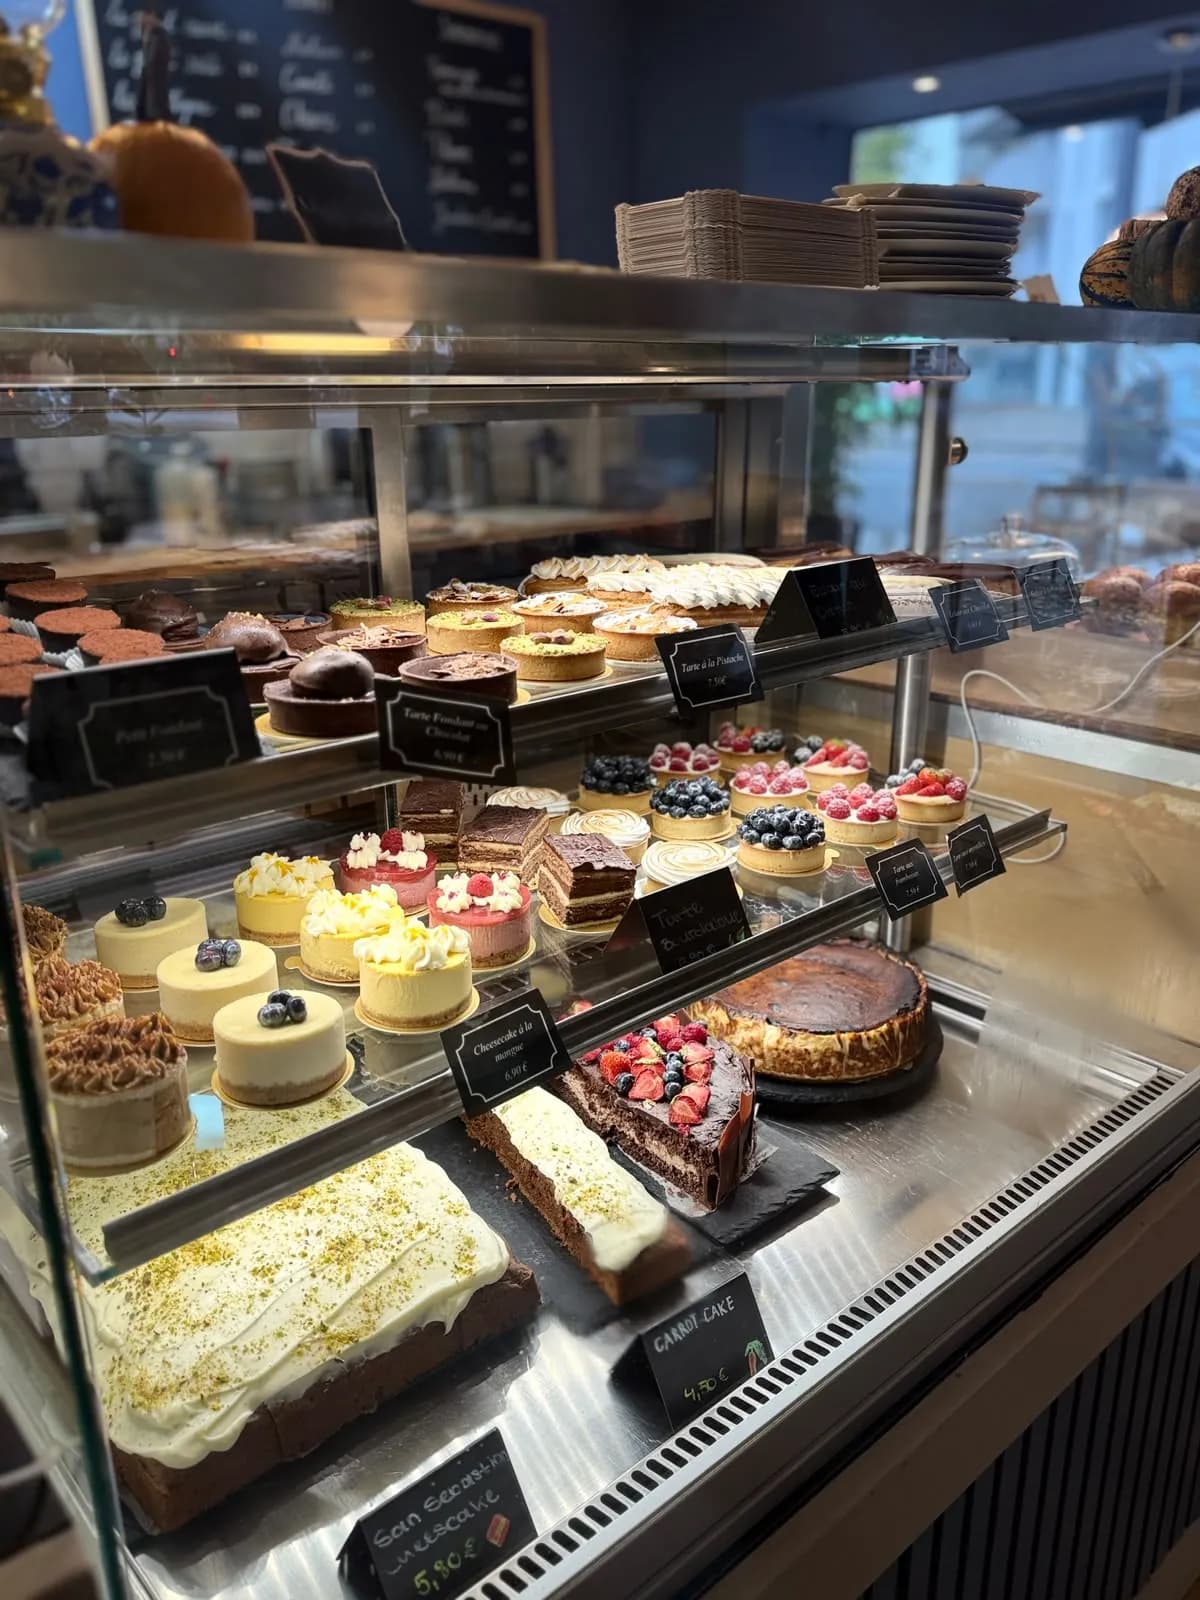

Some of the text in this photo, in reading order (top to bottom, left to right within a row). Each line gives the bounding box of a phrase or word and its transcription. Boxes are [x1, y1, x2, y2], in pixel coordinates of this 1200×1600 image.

[473, 1027, 518, 1056] Cheesecake
[524, 1020, 533, 1032] la
[494, 1042, 524, 1063] mangue
[653, 1294, 735, 1353] CARROT CAKE
[372, 1510, 423, 1548] San
